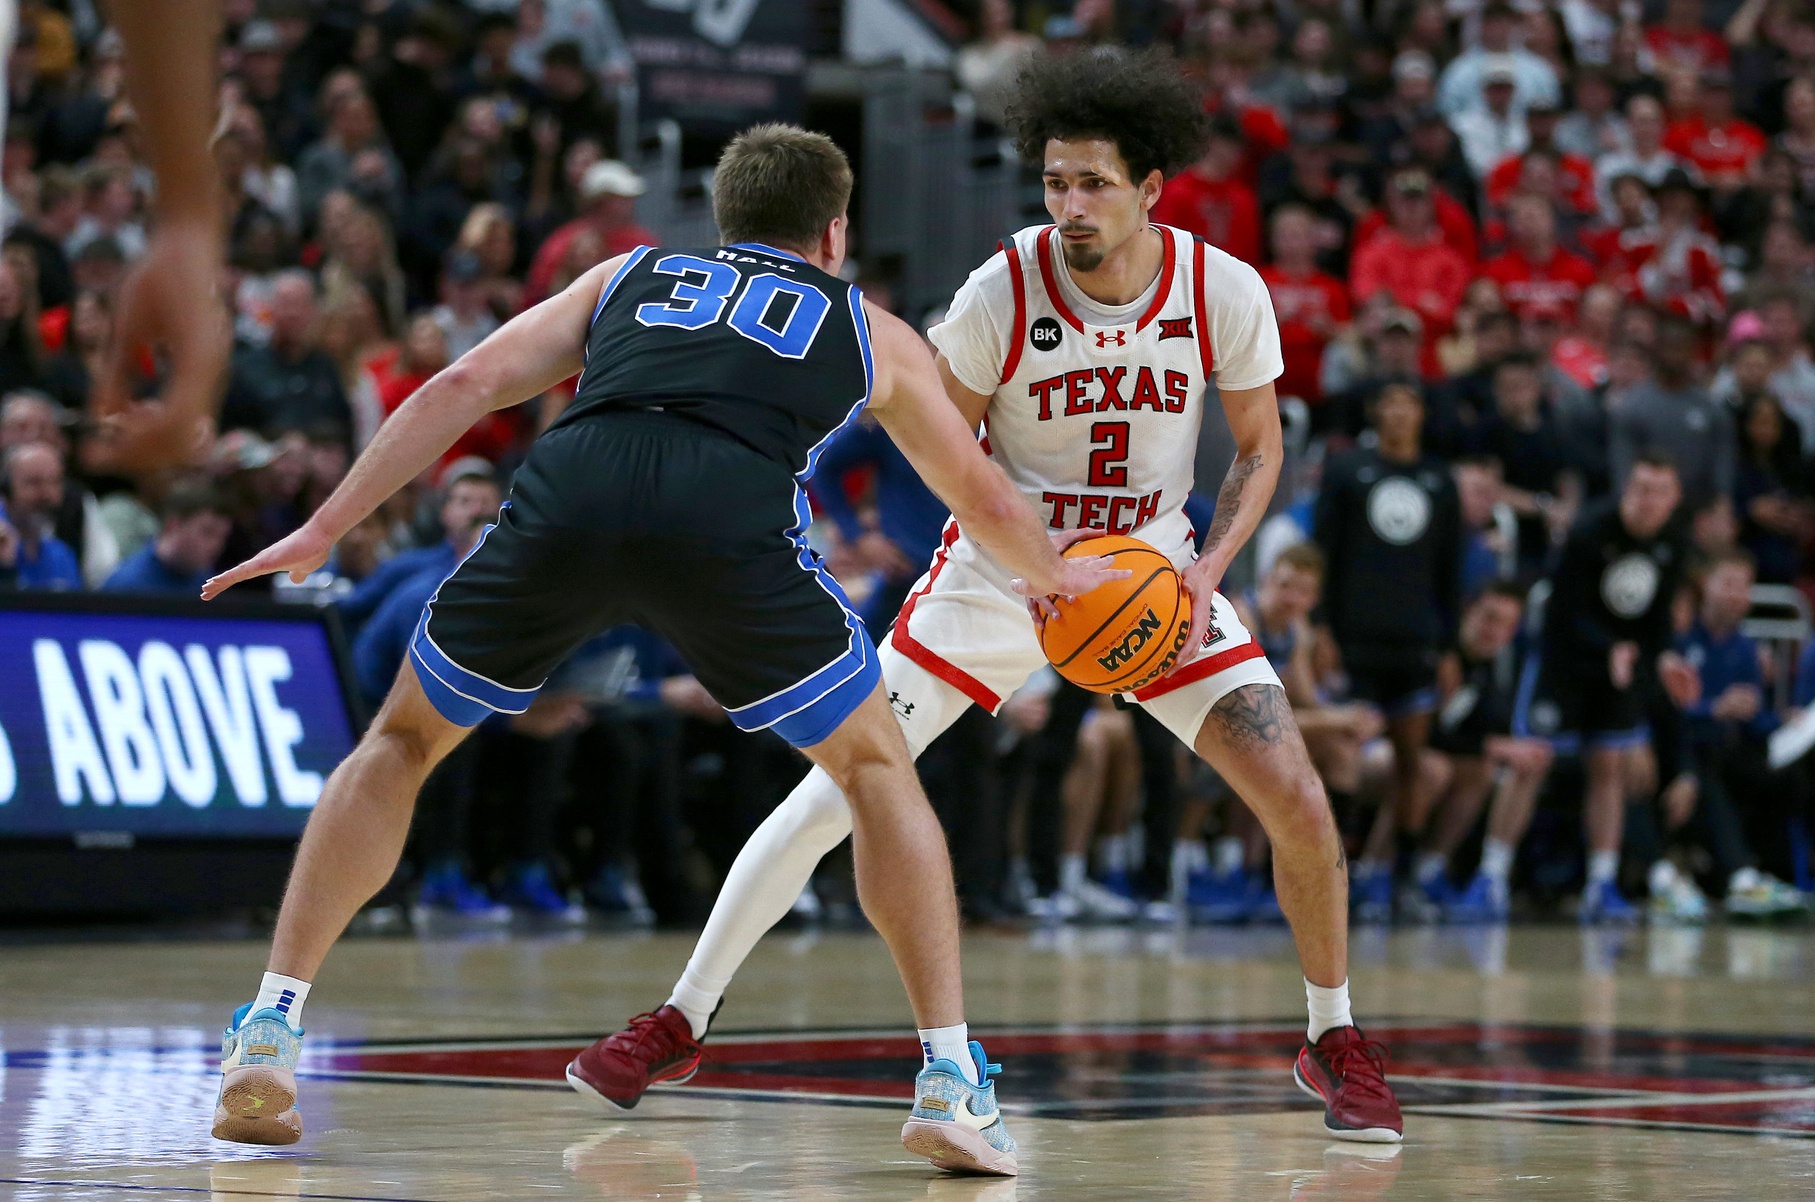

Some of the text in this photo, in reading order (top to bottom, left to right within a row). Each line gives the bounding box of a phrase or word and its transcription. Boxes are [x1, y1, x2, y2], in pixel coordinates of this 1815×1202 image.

[716, 249, 796, 273] HALL
[635, 254, 832, 359] 30
[1034, 328, 1057, 342] BK
[1029, 366, 1188, 420] TEXAS
[1087, 421, 1130, 487] 2
[1043, 489, 1162, 535] TECH
[1096, 608, 1162, 672] NCAA
[32, 638, 326, 808] ABOVE
